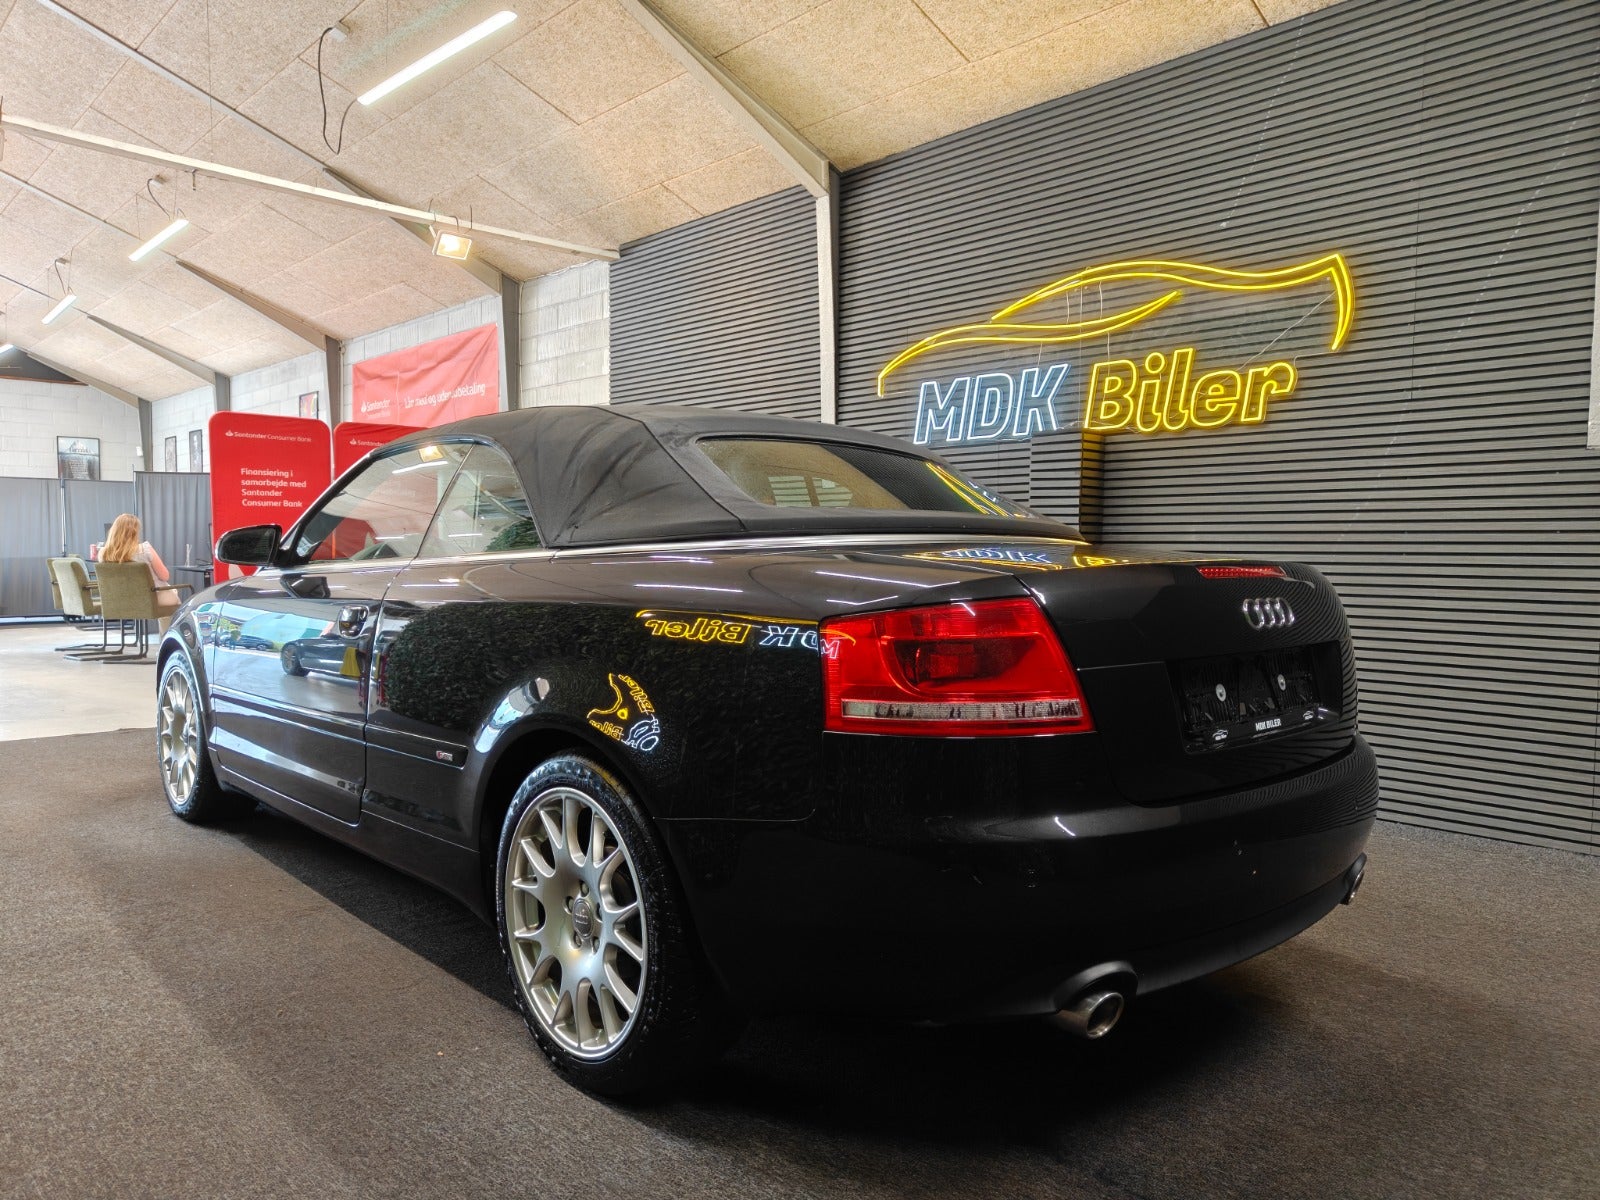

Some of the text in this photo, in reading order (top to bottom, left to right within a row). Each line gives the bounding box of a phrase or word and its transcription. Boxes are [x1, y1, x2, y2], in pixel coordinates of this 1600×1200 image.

[913, 347, 1297, 445] MDK Biler
[234, 431, 267, 439] Santander
[240, 467, 289, 478] Finansiering
[240, 478, 307, 488] samarbejde med
[241, 488, 283, 497] Santander
[241, 498, 303, 508] Consumer Bank
